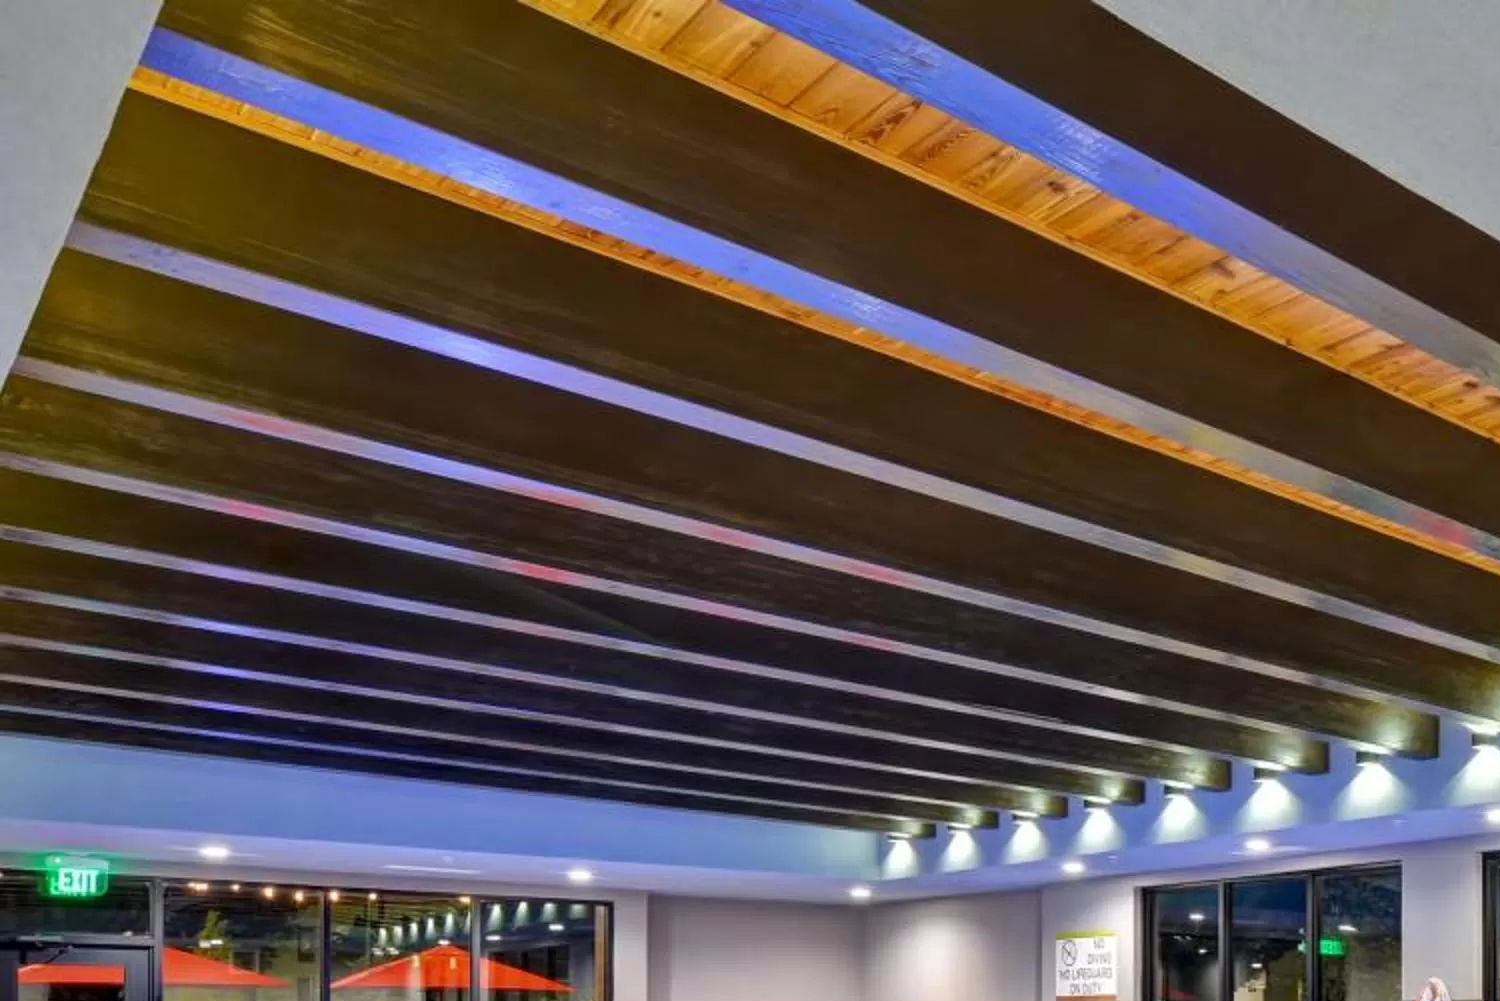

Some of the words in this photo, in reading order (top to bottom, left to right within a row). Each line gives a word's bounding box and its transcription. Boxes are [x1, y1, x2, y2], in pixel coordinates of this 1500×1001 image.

[59, 868, 98, 893] EXIT
[1093, 938, 1105, 949] NO
[1088, 952, 1112, 965] DIVING
[1059, 969, 1070, 981] NO
[1072, 967, 1113, 981] LIFEGUARD
[1069, 983, 1081, 994] ON
[1082, 981, 1102, 994] DUTY
